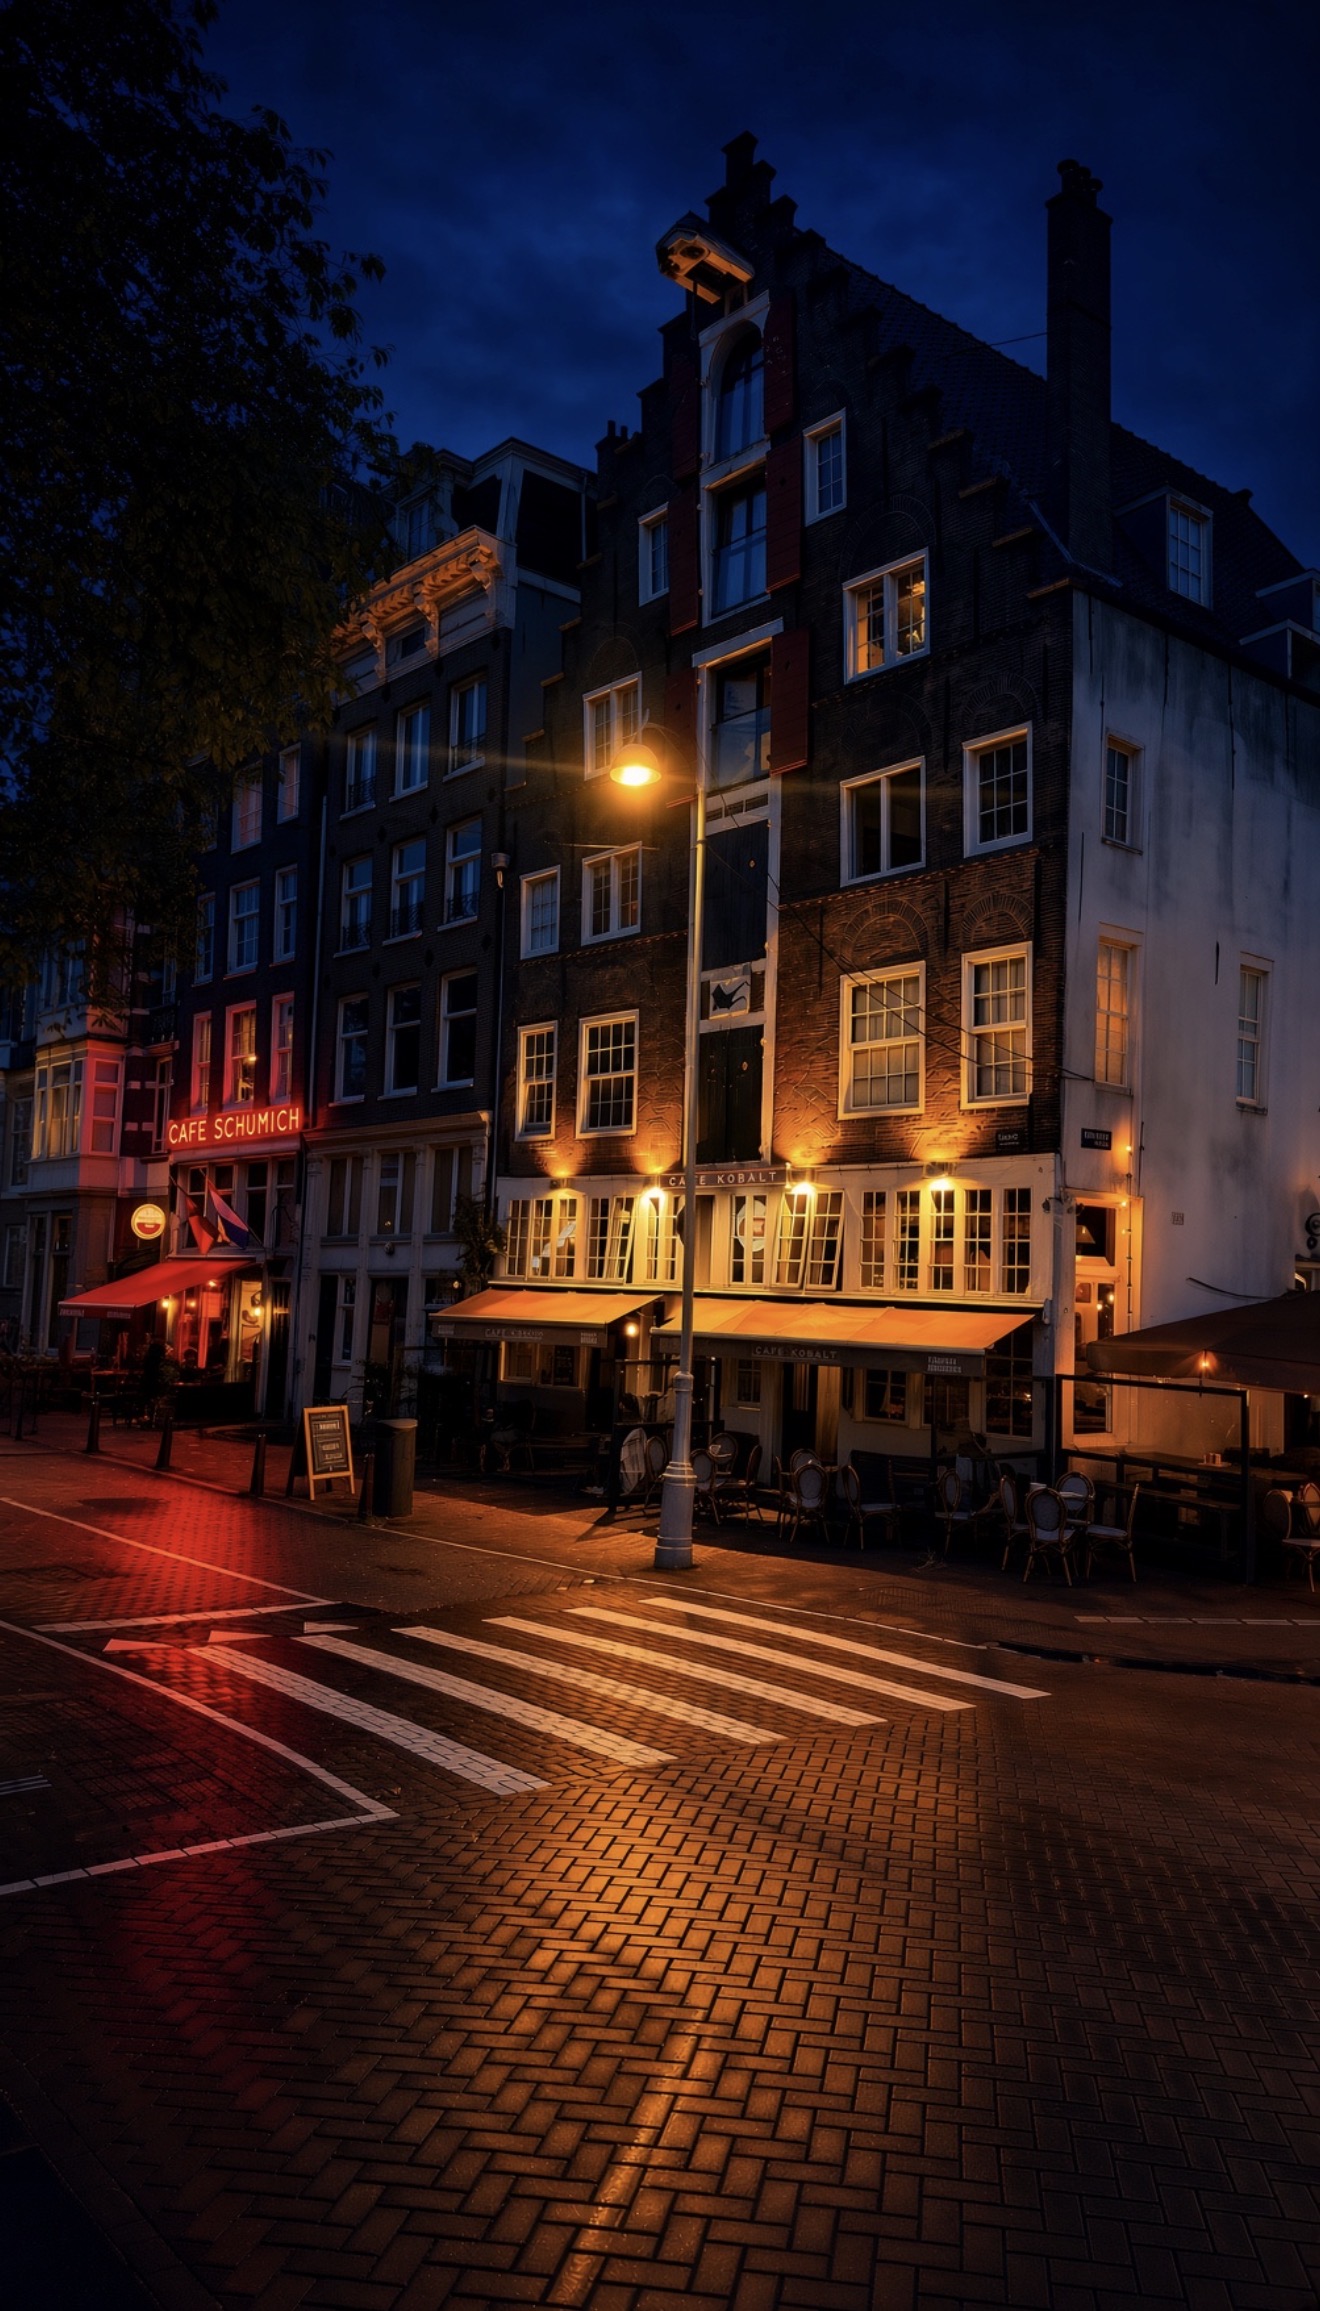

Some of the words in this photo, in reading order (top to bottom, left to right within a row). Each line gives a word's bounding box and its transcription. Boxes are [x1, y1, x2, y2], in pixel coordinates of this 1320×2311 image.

[168, 1120, 207, 1144] CAFE
[213, 1107, 300, 1140] SCHUMICH
[668, 1174, 707, 1187] CAE
[717, 1171, 777, 1184] KOBALT
[791, 1348, 838, 1359] KOBALT
